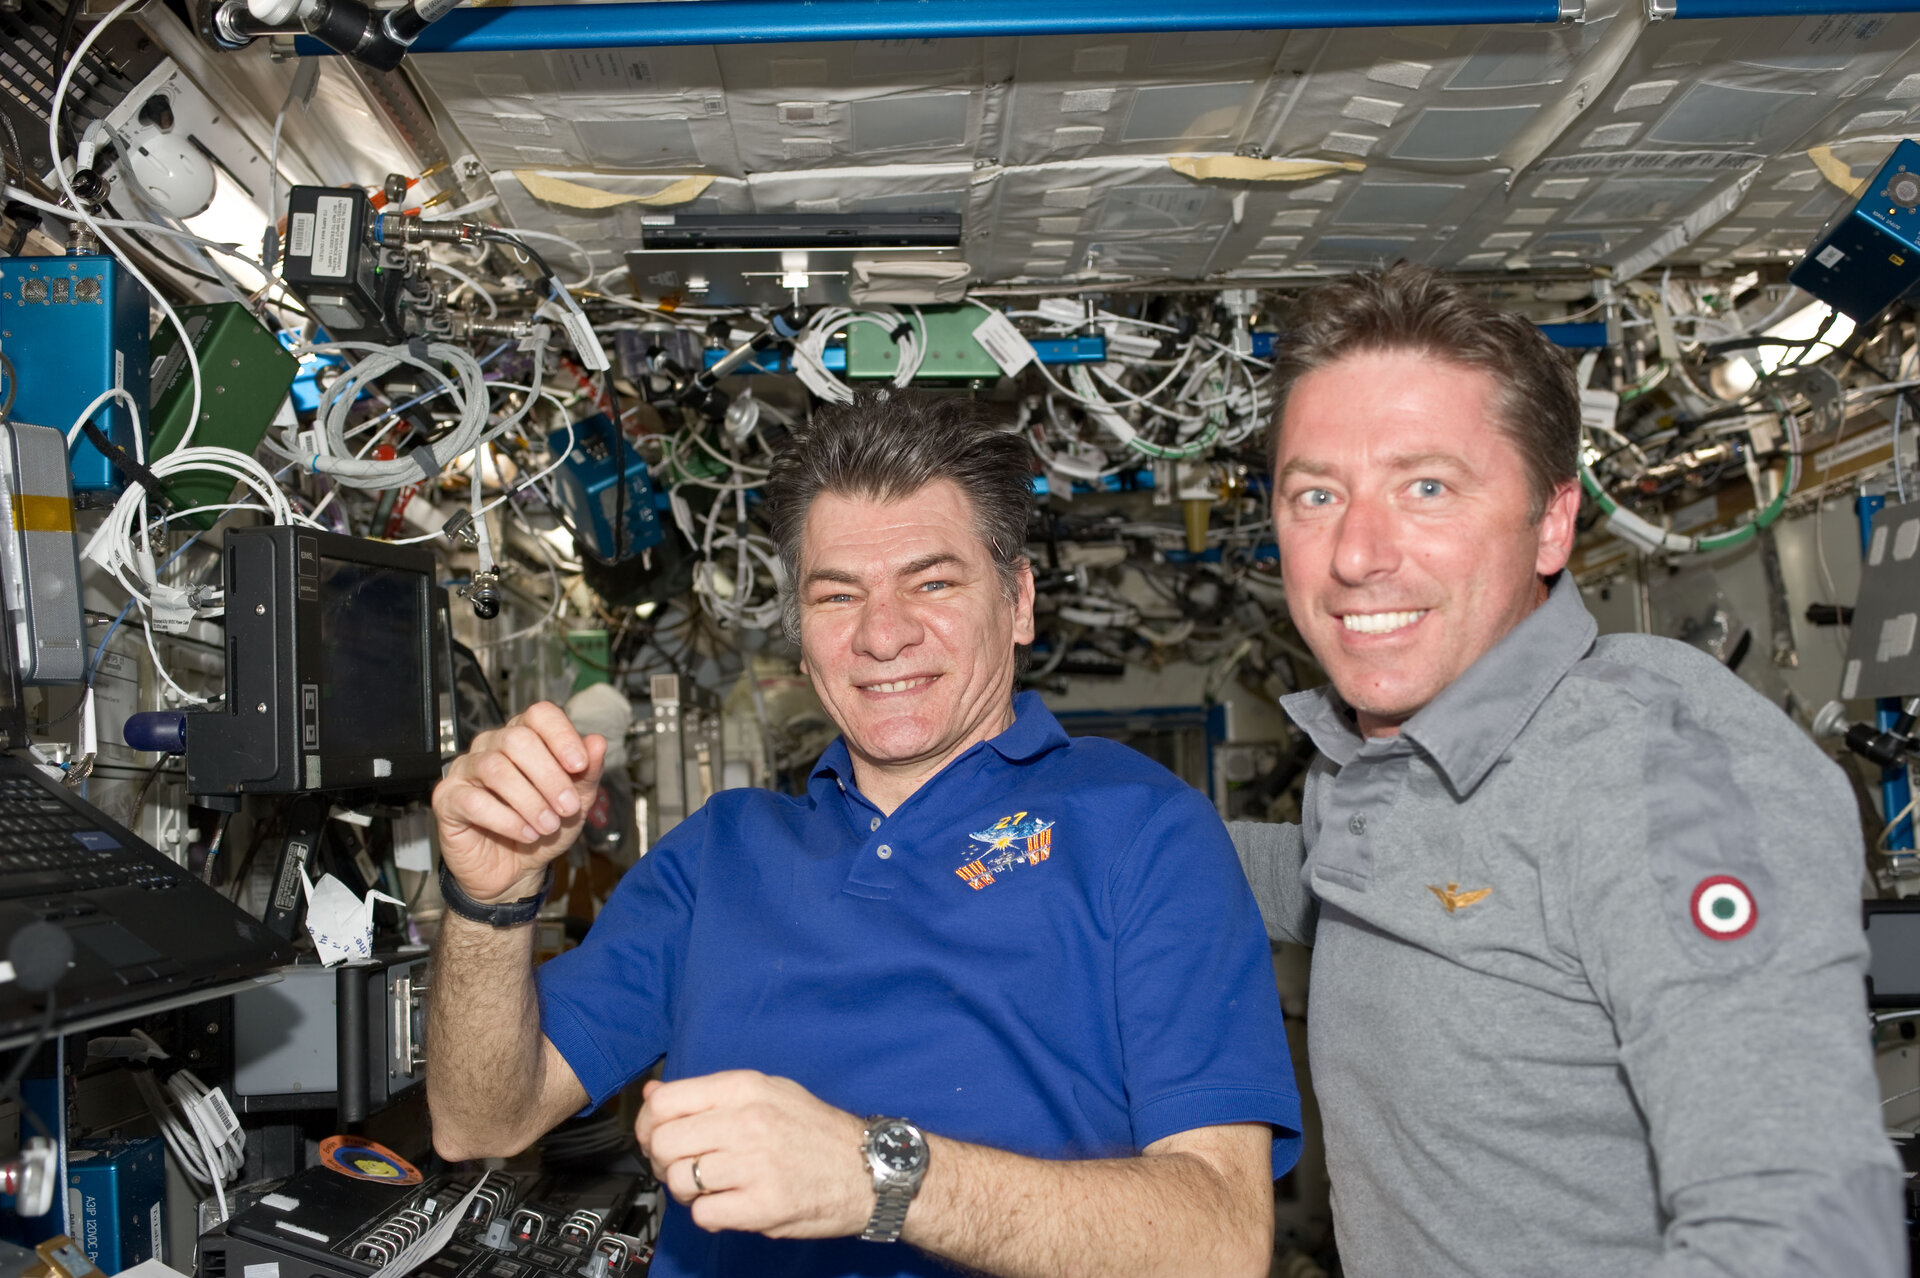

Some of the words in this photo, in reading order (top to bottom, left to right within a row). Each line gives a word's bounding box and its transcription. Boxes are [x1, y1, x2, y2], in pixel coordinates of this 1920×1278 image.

[994, 811, 1028, 830] 27
[86, 1195, 97, 1216] A31P
[86, 1219, 98, 1249] 120VDC
